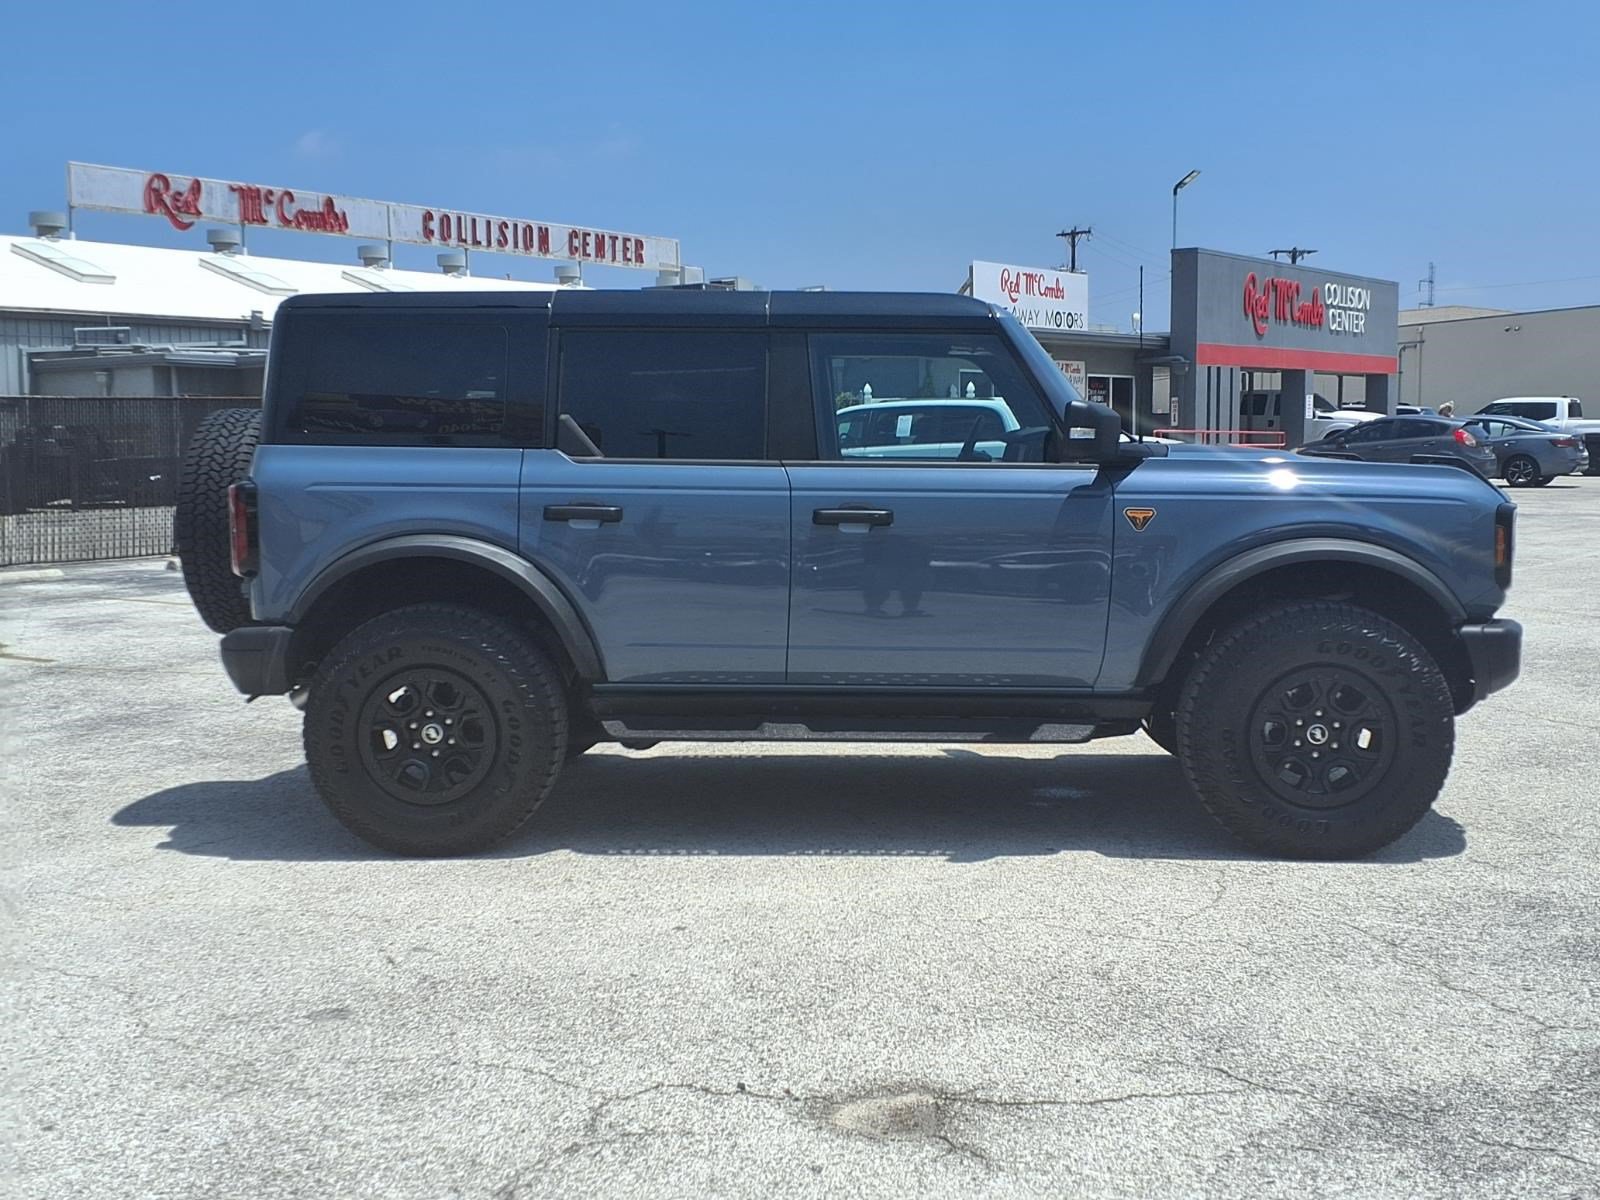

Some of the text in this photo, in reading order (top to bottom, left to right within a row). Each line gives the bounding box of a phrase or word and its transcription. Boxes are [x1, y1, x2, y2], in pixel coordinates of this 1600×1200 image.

[143, 173, 645, 264] Red McCombs COLLISION CENTER
[1000, 267, 1065, 303] Red McCombs
[1324, 282, 1371, 311] COLLISION
[1044, 308, 1084, 329] MOTORS
[1243, 271, 1326, 336] Red McCombs
[1329, 308, 1365, 333] CENTER
